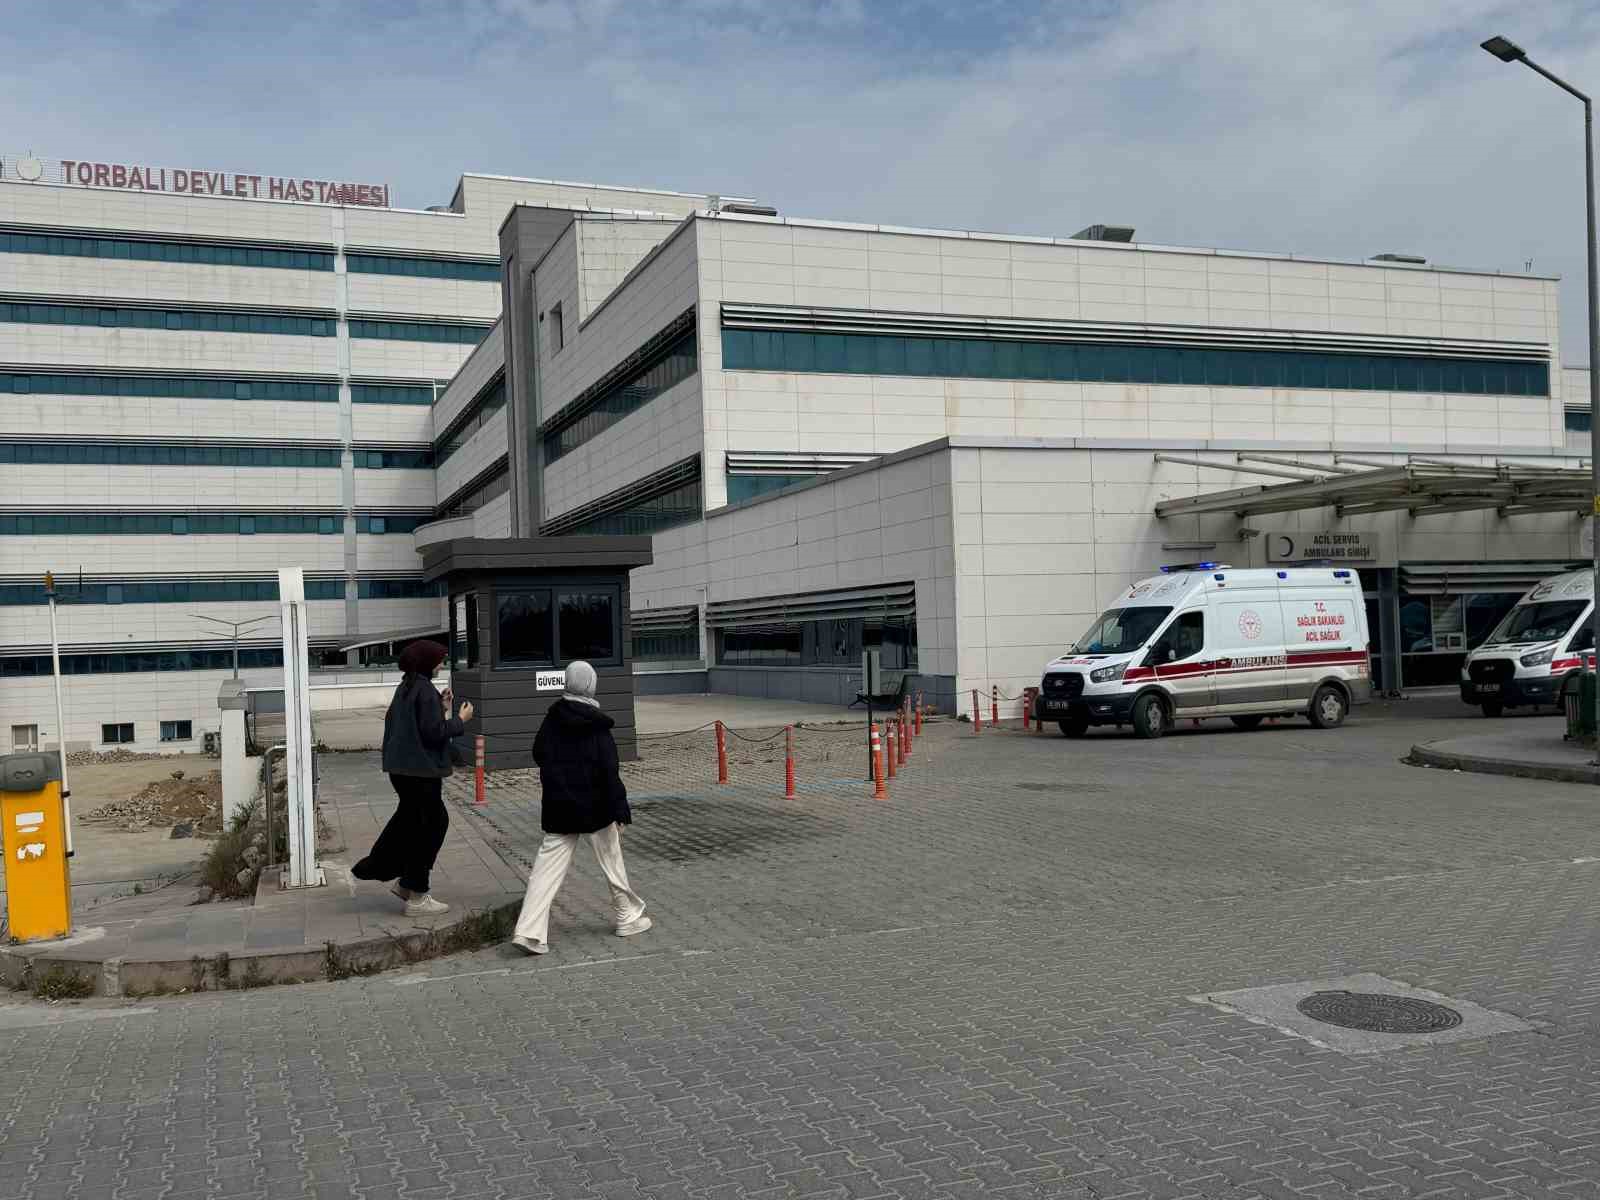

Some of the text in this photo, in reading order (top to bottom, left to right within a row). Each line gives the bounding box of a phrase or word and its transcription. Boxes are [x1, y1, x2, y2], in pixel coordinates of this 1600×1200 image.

[61, 160, 389, 208] TORBALI DEVLET HASTANESİ
[1231, 656, 1287, 668] AMBULANS
[538, 676, 565, 687] GÜVENL
